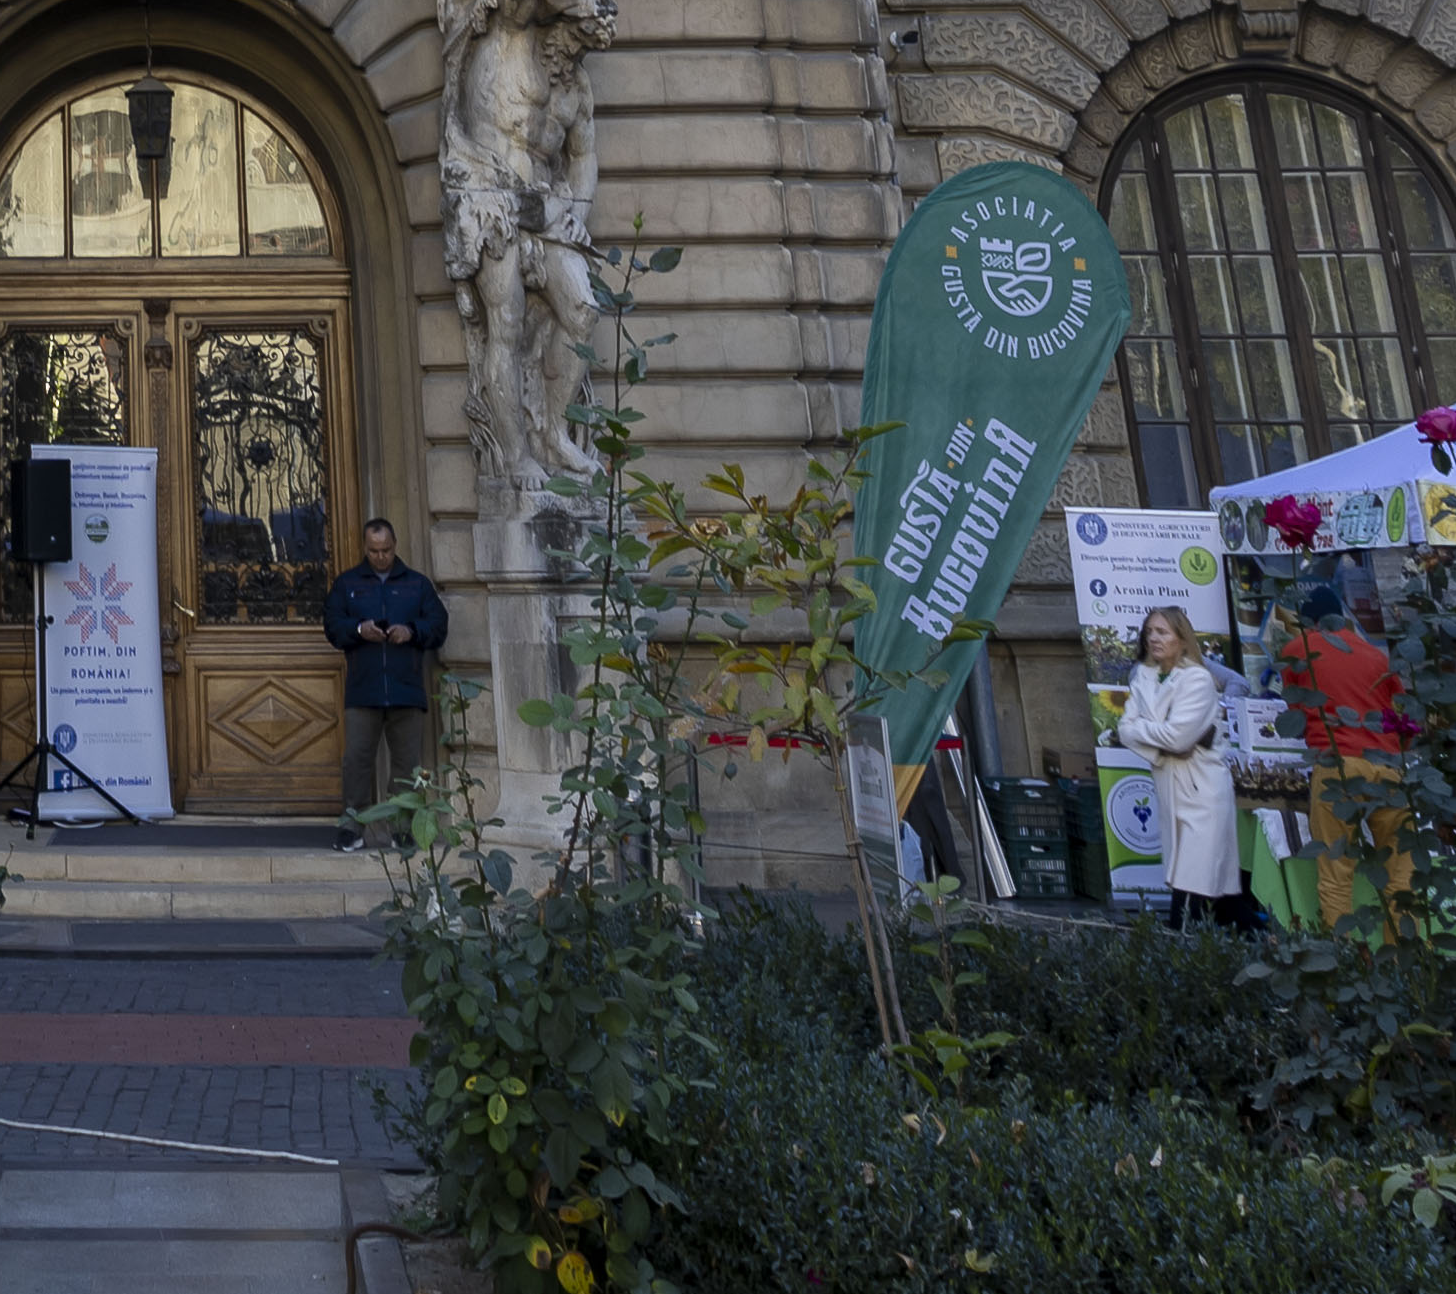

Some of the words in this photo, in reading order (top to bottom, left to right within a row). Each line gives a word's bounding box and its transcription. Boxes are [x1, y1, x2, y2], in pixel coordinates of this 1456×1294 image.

[950, 196, 1077, 253] ASOCIAȚIA
[941, 264, 983, 334] GUSTĂ
[983, 325, 1019, 359] DIN
[1026, 278, 1093, 360] BUCOVINA
[945, 421, 976, 466] DIN
[1113, 584, 1154, 597] Aronia
[1158, 585, 1190, 598] Plant
[116, 646, 137, 657] DIN
[71, 665, 130, 679] ROMÂNIA!
